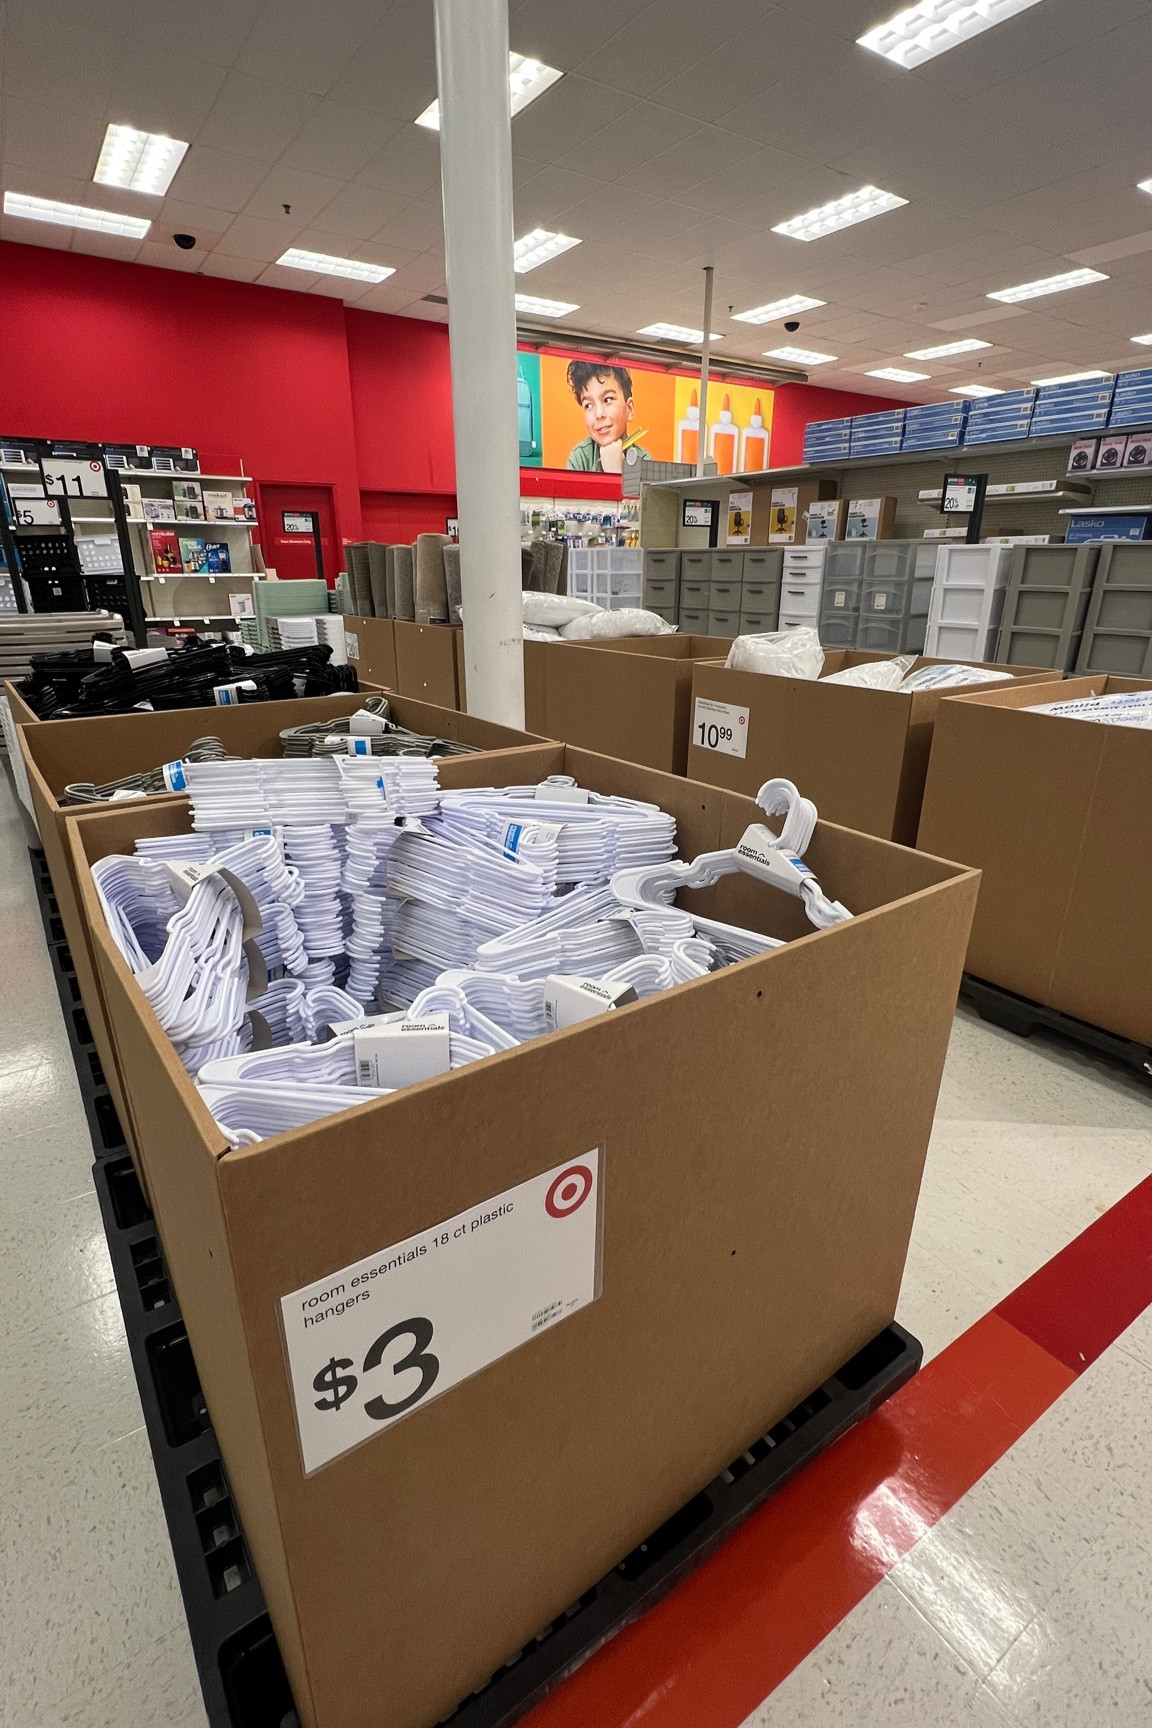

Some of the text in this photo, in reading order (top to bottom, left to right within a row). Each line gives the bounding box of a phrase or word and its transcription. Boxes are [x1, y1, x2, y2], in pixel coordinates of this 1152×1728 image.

[45, 474, 84, 496] $11
[1071, 519, 1105, 528] Lasko
[738, 849, 771, 867] essentials
[739, 844, 758, 855] room
[301, 1202, 515, 1311] room essentials 18 ct plastic
[303, 1289, 371, 1329] hangers
[312, 1316, 440, 1421] $3
